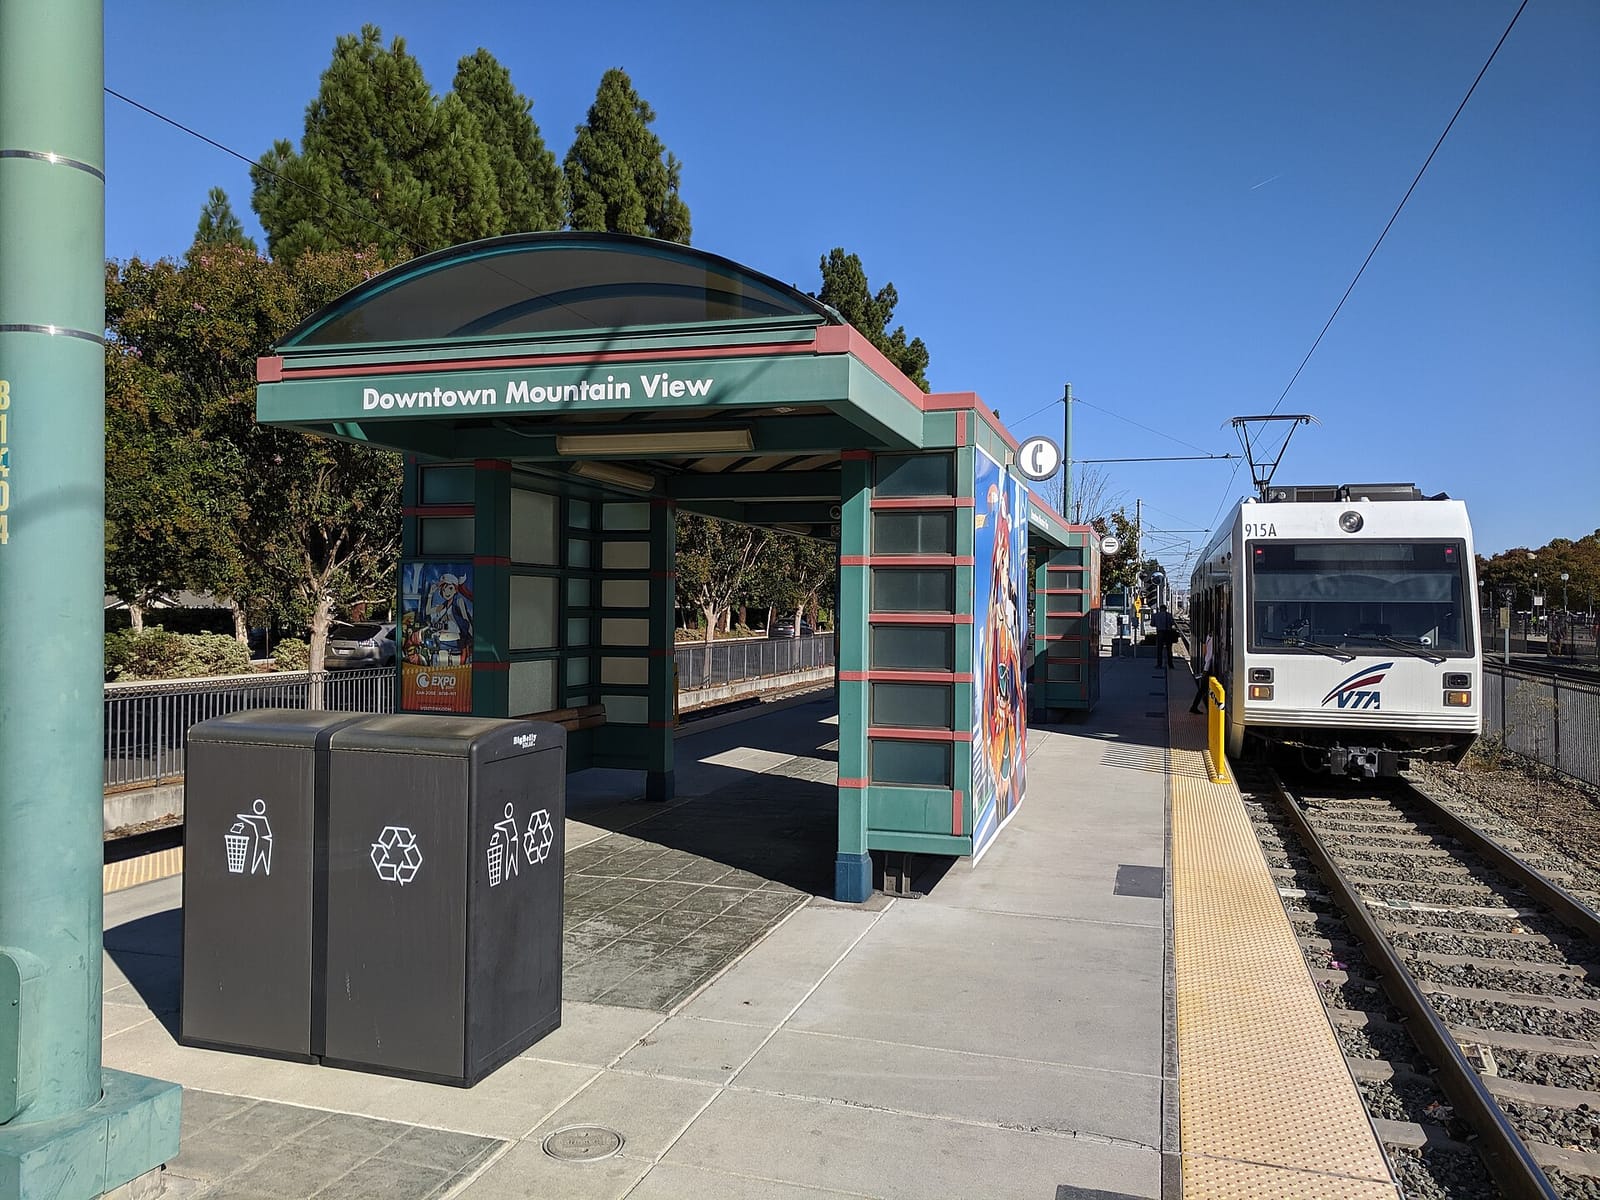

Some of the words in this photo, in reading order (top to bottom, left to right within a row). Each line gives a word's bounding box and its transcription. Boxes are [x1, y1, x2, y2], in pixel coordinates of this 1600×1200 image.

[363, 387, 497, 410] Downtown
[505, 375, 631, 404] Mountain
[640, 372, 713, 398] View
[1245, 523, 1277, 537] 915A
[432, 676, 456, 690] EXPO
[1337, 690, 1381, 709] VTA
